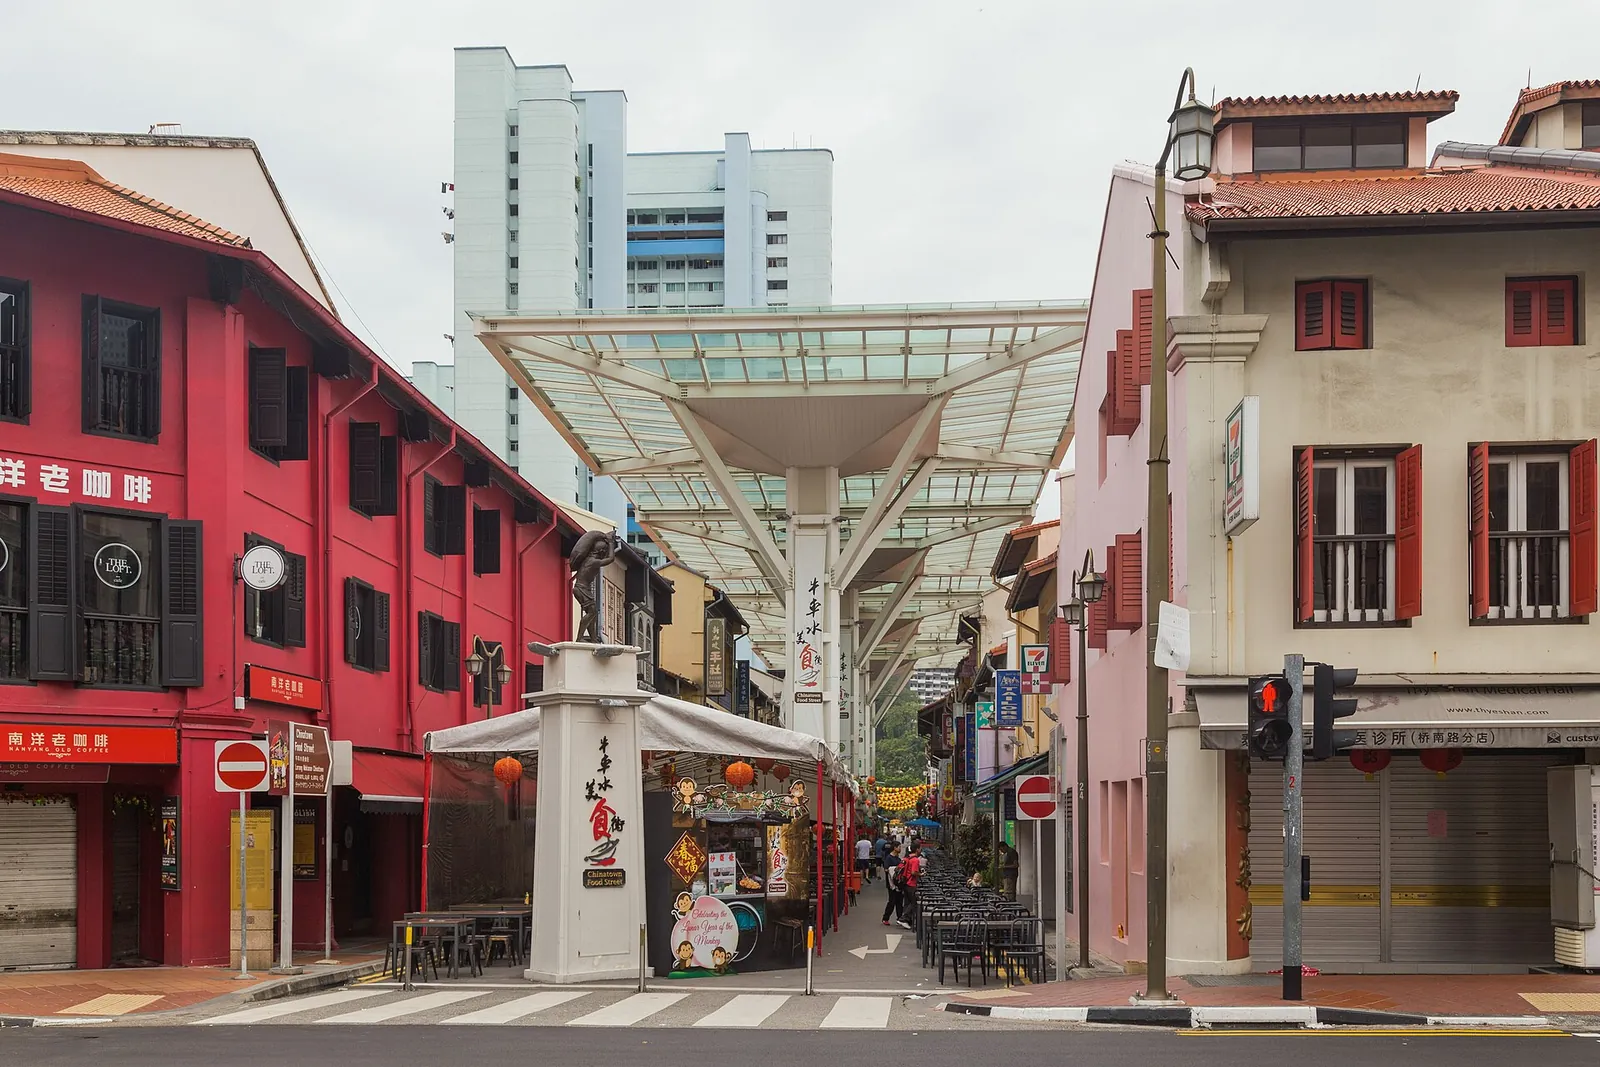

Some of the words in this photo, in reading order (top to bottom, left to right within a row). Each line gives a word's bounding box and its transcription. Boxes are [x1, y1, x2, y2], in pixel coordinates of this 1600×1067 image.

[0, 458, 152, 504] 洋老咖啡
[106, 562, 132, 574] LOFT.
[108, 558, 128, 566] THE
[1028, 650, 1045, 667] 7
[1000, 686, 1018, 720] TAILORS
[1446, 706, 1550, 716] www.thyeshan.com
[8, 732, 108, 747] 南洋老咖啡
[1289, 776, 1295, 788] 2
[692, 909, 719, 920] Celebrating
[681, 921, 699, 933] Lunar
[700, 920, 717, 935] Year
[719, 922, 725, 934] of
[694, 934, 720, 945] Monkey
